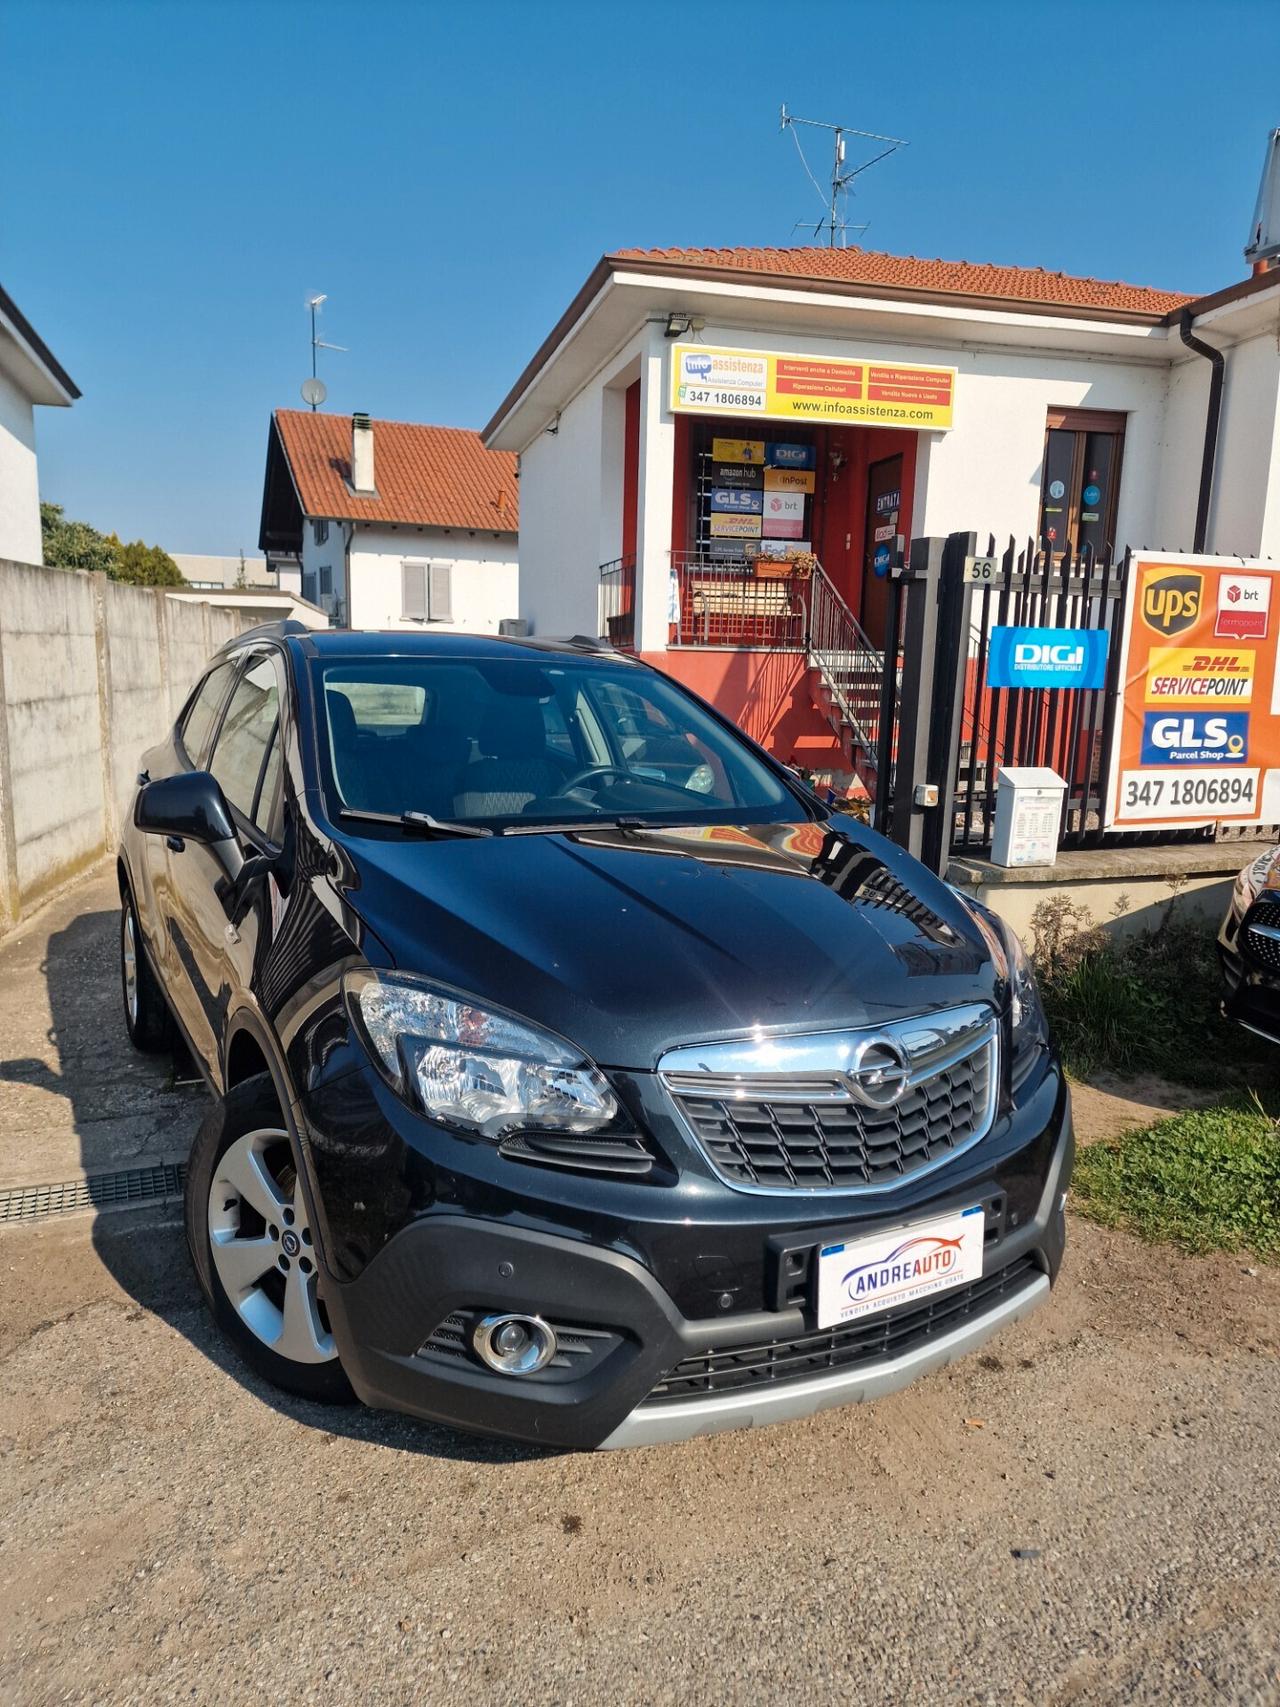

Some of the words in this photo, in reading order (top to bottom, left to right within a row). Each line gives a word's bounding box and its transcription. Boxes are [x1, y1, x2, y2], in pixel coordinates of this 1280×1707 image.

[712, 358, 763, 374] assistenza
[689, 391, 710, 402] 347
[714, 393, 762, 406] 1806894
[792, 400, 933, 420] www.infoassistenza.com
[775, 449, 807, 459] DIGI
[719, 467, 743, 477] amazon
[743, 466, 757, 478] hub
[715, 492, 752, 505] GLS
[784, 501, 798, 511] brt
[877, 493, 900, 511] ENTRATA
[971, 562, 993, 579] 56
[1243, 589, 1260, 601] brt
[1146, 588, 1198, 627] ups
[1014, 644, 1085, 664] DIGI
[1014, 663, 1054, 672] DISTRIBUTORE
[1192, 656, 1241, 672] DHL
[1151, 677, 1249, 696] SERVICEPOINT
[1151, 717, 1229, 749] GLS
[1169, 750, 1199, 760] Parcel
[1199, 750, 1225, 761] Shop
[1125, 779, 1164, 808] 347
[1169, 778, 1254, 806] 1806894
[855, 1249, 952, 1295] ANDREAUTO
[840, 1304, 870, 1318] VENDITA
[873, 1293, 906, 1308] ACQUISTO
[909, 1282, 942, 1297] MACCHINE
